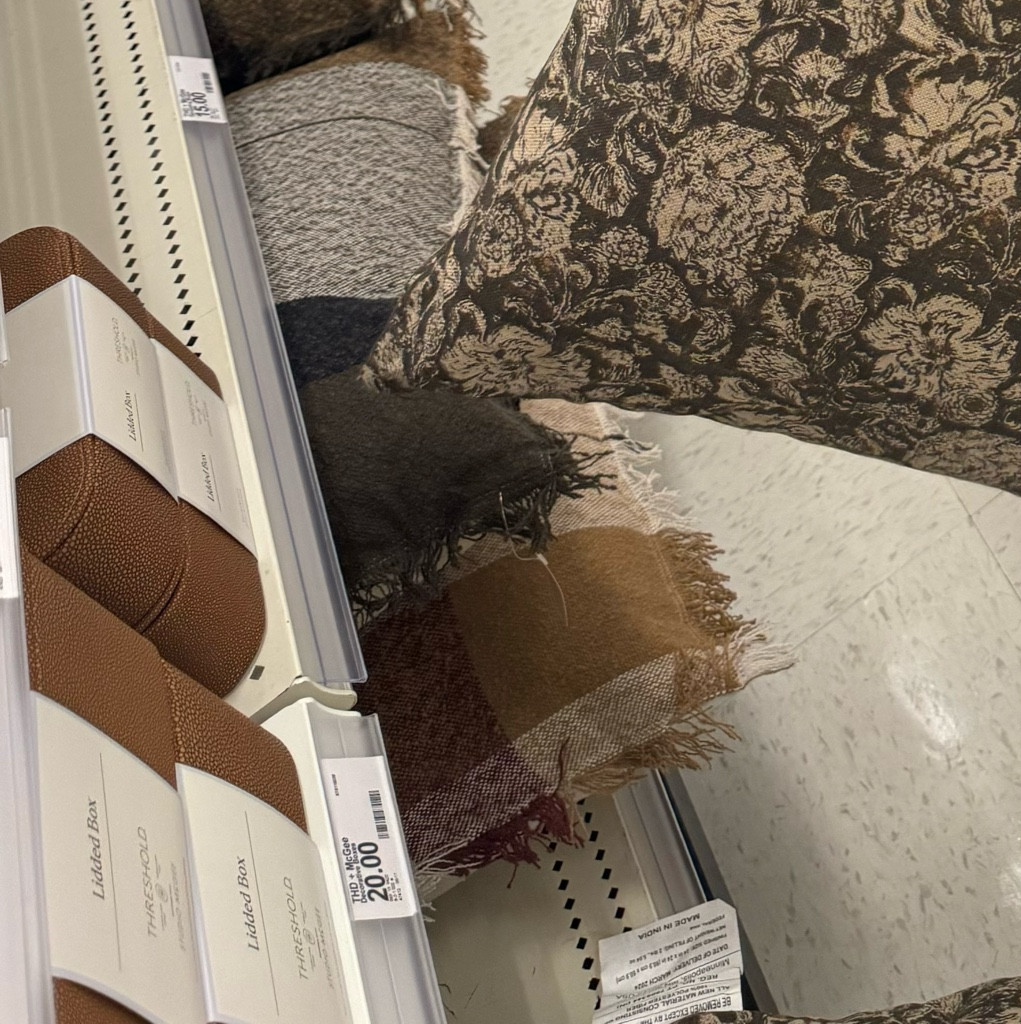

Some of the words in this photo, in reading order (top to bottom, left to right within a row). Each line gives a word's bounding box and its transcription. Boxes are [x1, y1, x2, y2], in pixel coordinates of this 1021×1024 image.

[191, 92, 210, 115] 15.00
[126, 402, 137, 441] Lidded
[203, 467, 214, 501] Lidded
[87, 796, 100, 833] Box
[342, 837, 354, 871] McGee
[351, 842, 359, 864] Boxes
[88, 835, 104, 900] Lidded
[237, 856, 250, 889] Box
[358, 842, 389, 902] 20.00
[138, 826, 157, 938] THRESHOLD
[350, 882, 361, 904] THD
[356, 865, 367, 903] Decorative
[239, 891, 259, 951] Lidded
[284, 877, 308, 980] THRESHOLD
[663, 922, 673, 931] IN
[674, 913, 700, 927] MADE
[637, 926, 661, 940] INDIA
[704, 950, 712, 959] OF
[713, 943, 728, 955] DATE
[650, 970, 671, 985] MARCH
[680, 957, 730, 983] Minneapolis,
[648, 988, 689, 1004] POLYESTER
[661, 992, 696, 1007] MATERIAL
[689, 998, 722, 1015] REMOVED
[721, 996, 732, 1007] BE
[615, 1002, 659, 1021] CONSISTING
[664, 1007, 689, 1021] EXCEPT
